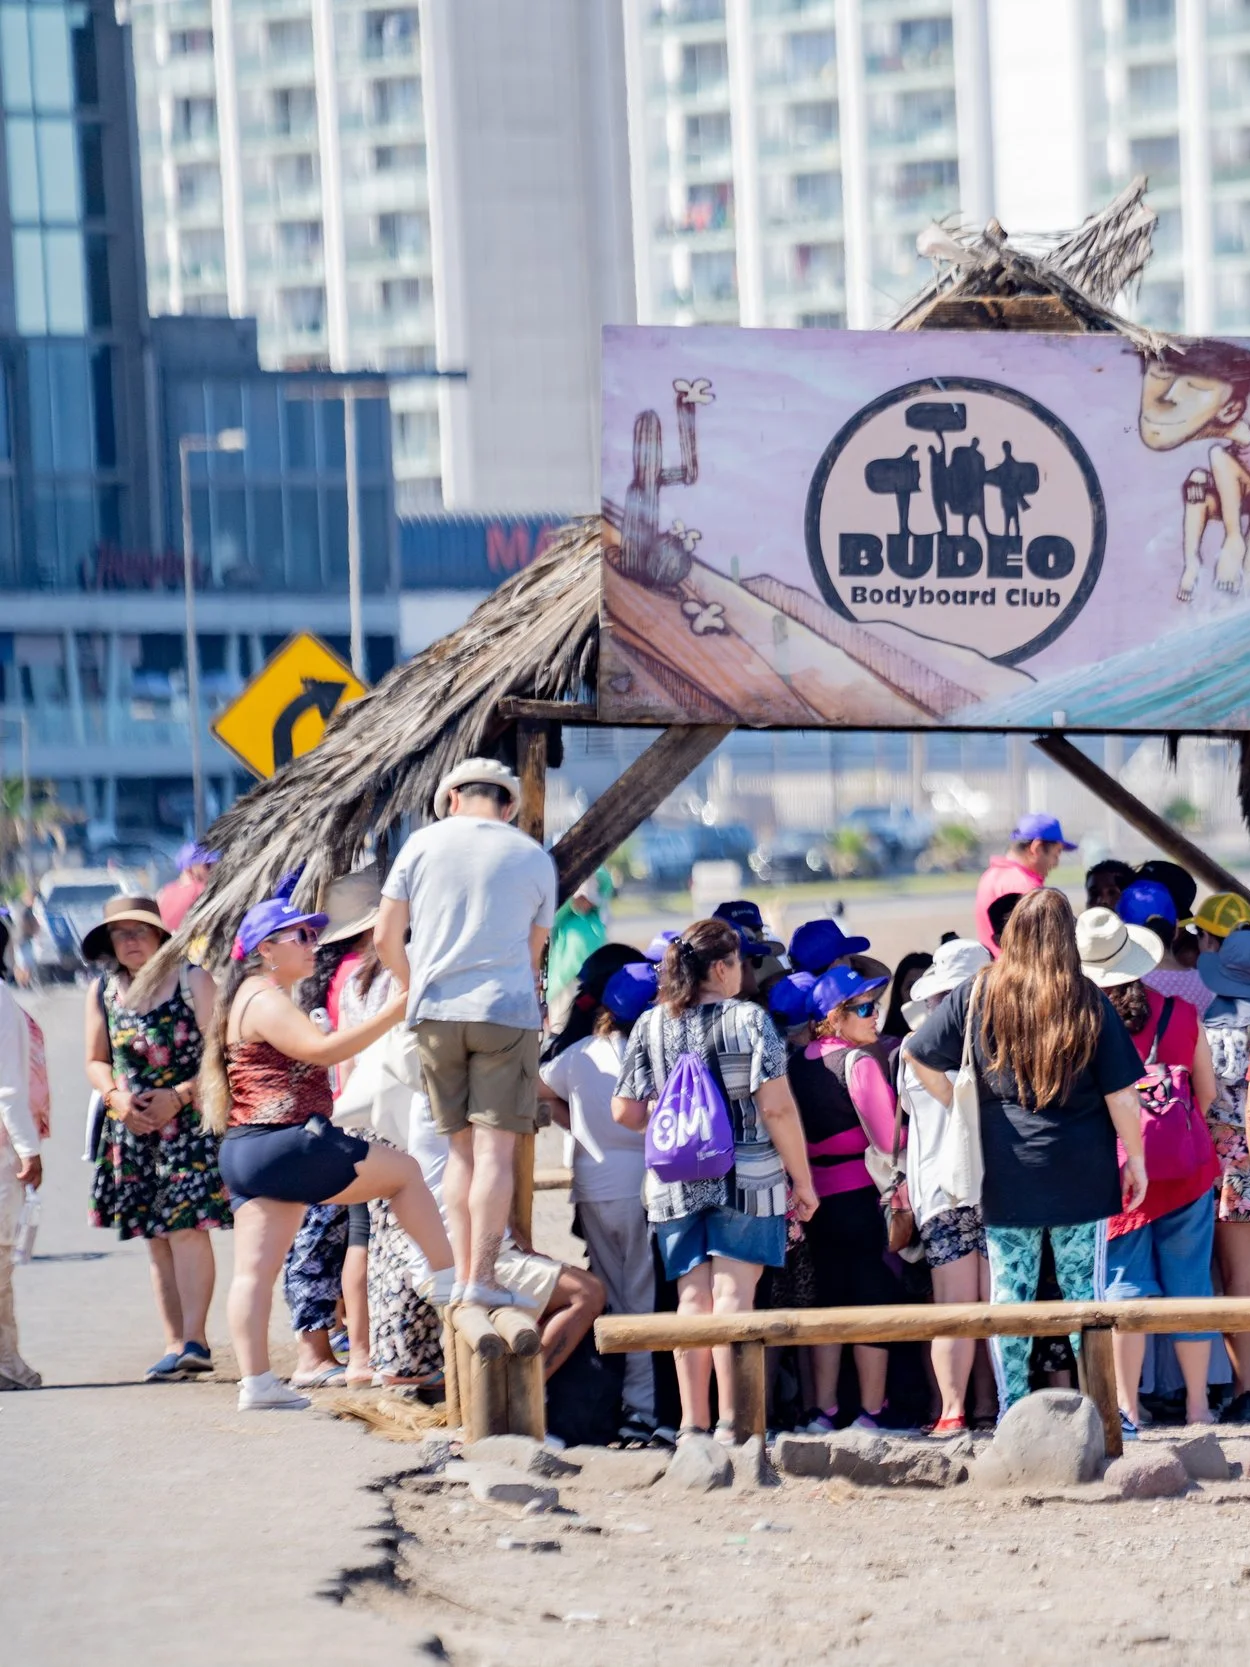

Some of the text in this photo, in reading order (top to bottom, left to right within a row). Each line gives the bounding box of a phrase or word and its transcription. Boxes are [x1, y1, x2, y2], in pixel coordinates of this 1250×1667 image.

[839, 533, 1076, 580] BUDEO
[851, 586, 1061, 608] Bodyboard Club
